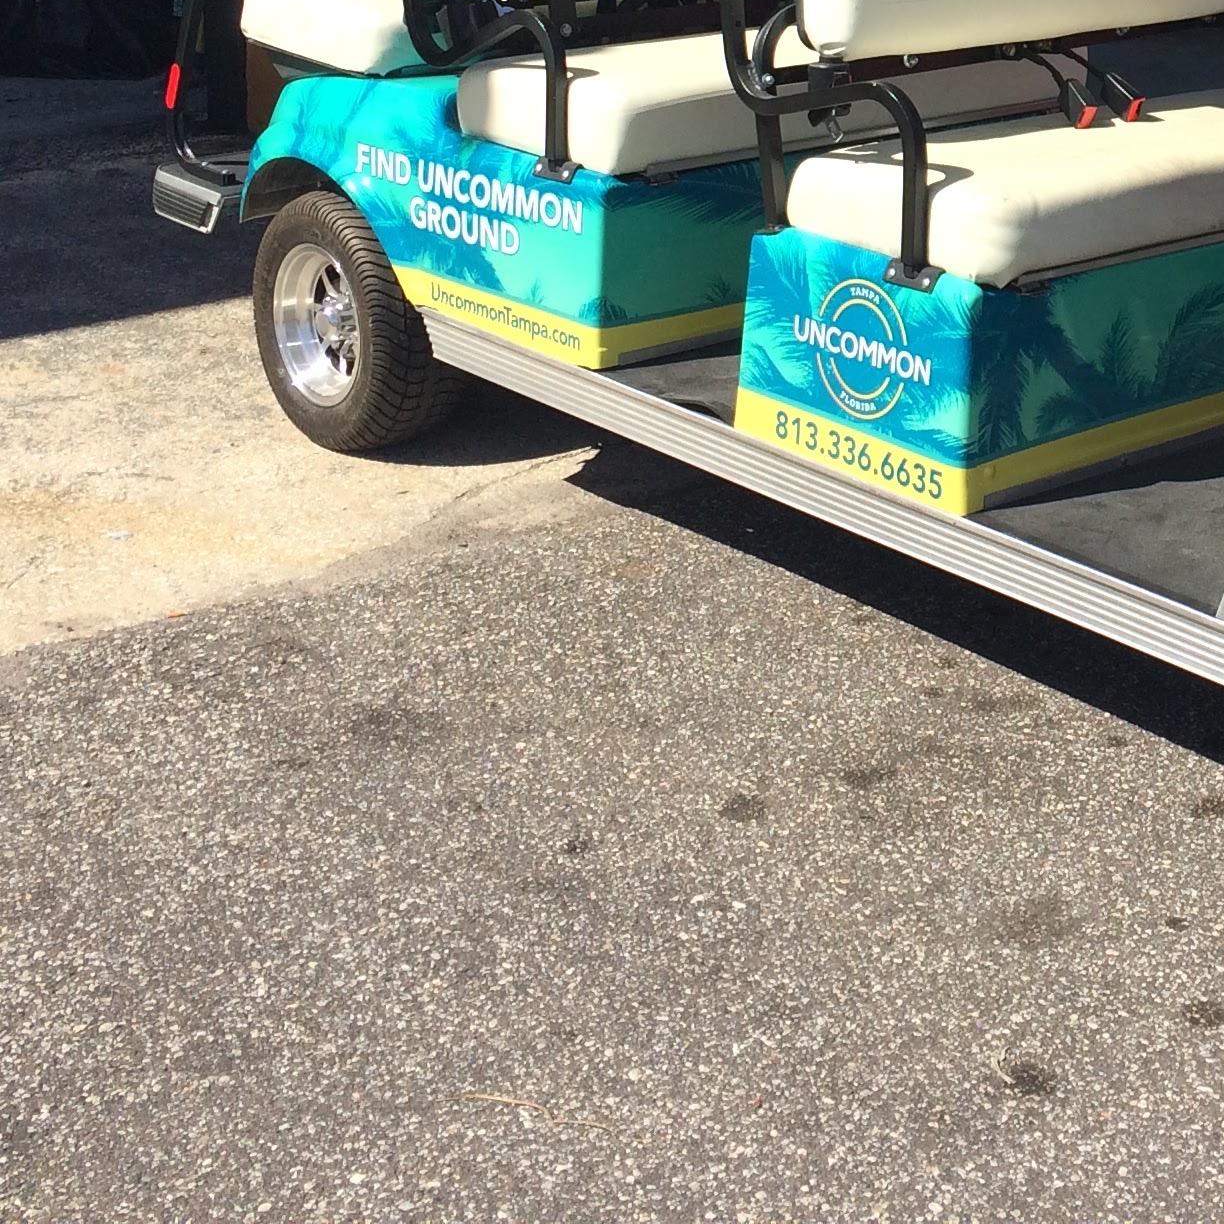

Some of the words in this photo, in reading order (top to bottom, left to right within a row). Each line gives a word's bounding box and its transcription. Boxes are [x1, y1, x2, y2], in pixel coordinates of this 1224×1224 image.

[355, 143, 411, 185] FIND
[418, 158, 583, 234] UNCOMMON
[410, 196, 520, 255] GROUND
[430, 281, 581, 350] UncommonTampa.com
[850, 287, 880, 305] TAMPA
[793, 314, 932, 386] UNCOMMON
[839, 390, 877, 412] FLORIDA
[775, 410, 943, 500] 813.336.6635
